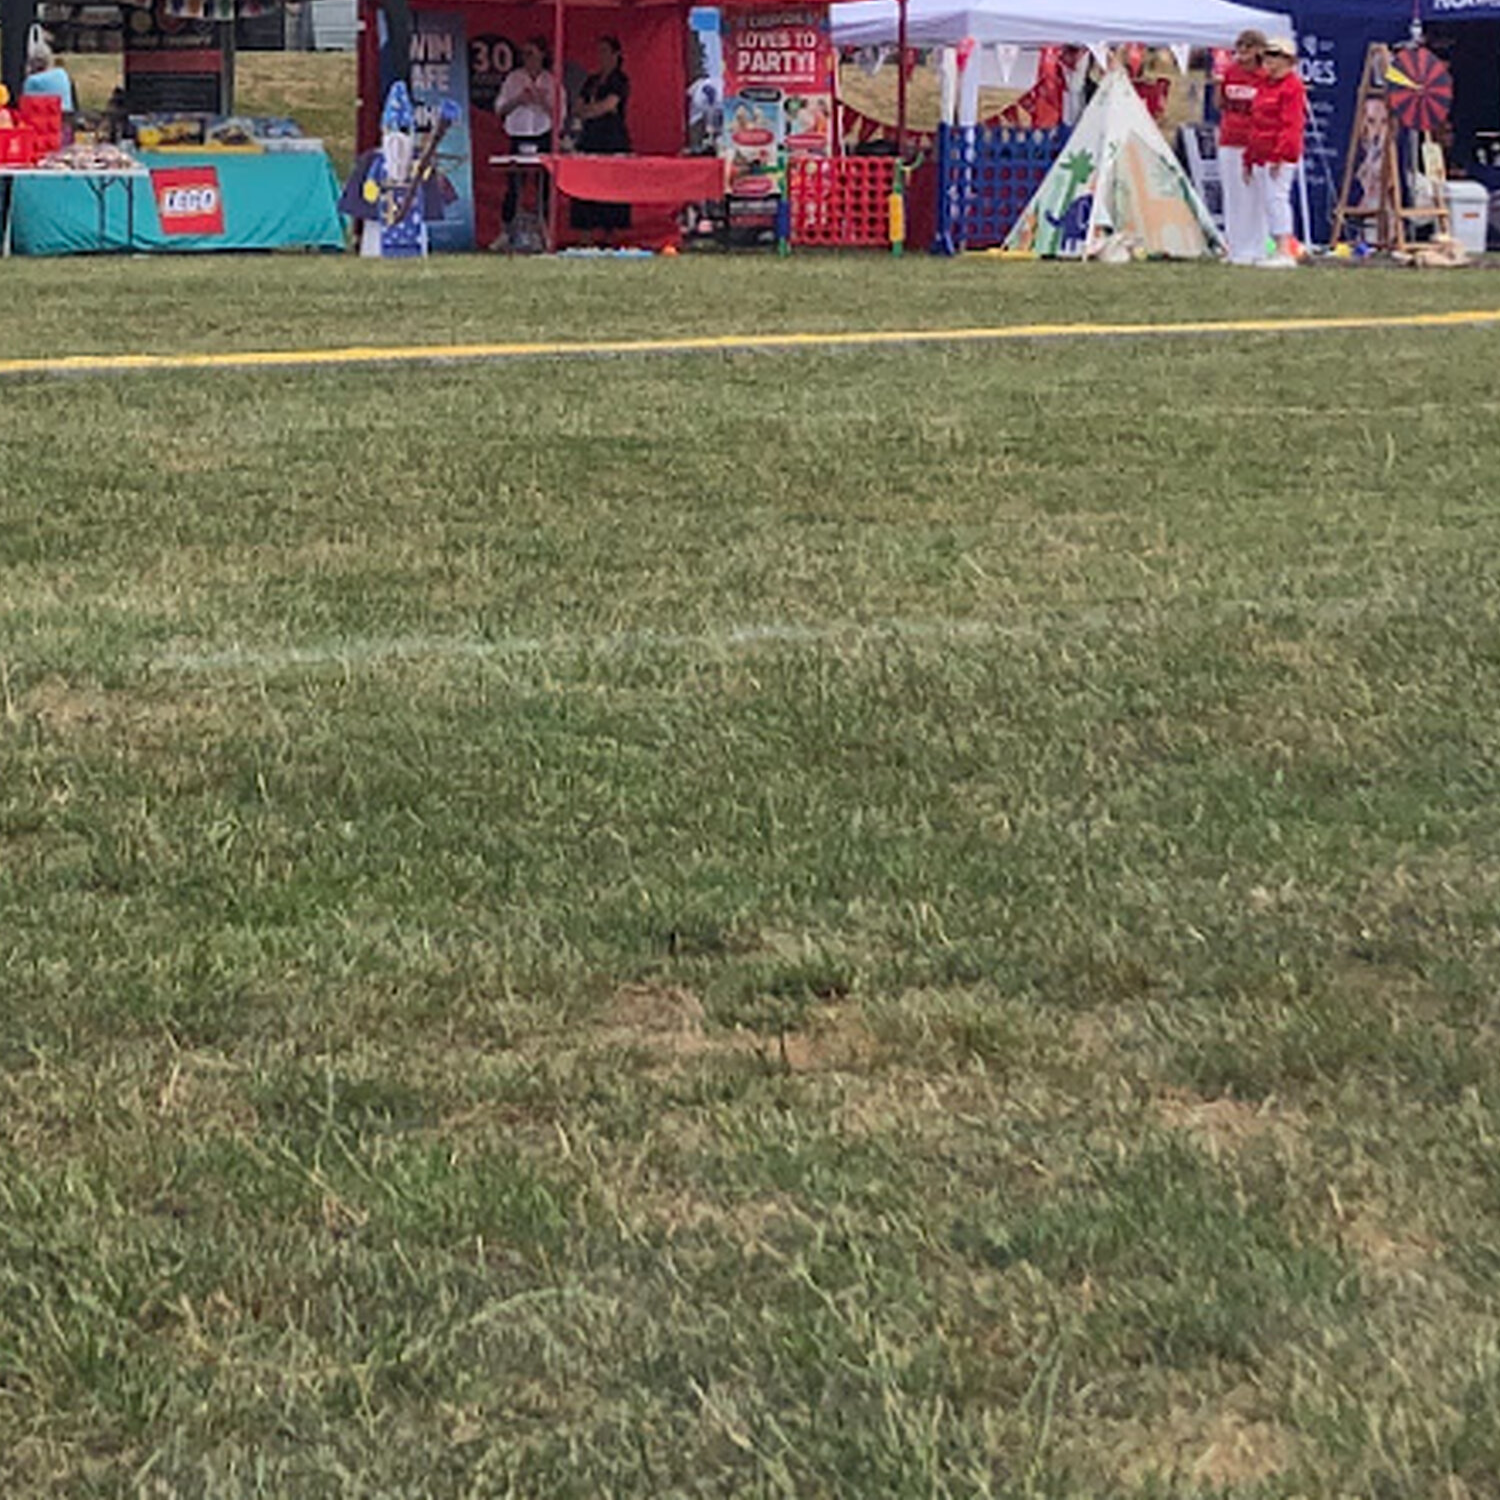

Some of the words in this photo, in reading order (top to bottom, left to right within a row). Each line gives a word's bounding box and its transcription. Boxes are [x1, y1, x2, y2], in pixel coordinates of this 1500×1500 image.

[409, 33, 452, 61] WIM
[736, 31, 791, 48] LOVES
[795, 30, 817, 48] TO
[472, 41, 514, 72] 30
[736, 51, 816, 73] PARTY!
[410, 63, 451, 91] AFE
[1299, 58, 1337, 85] OES
